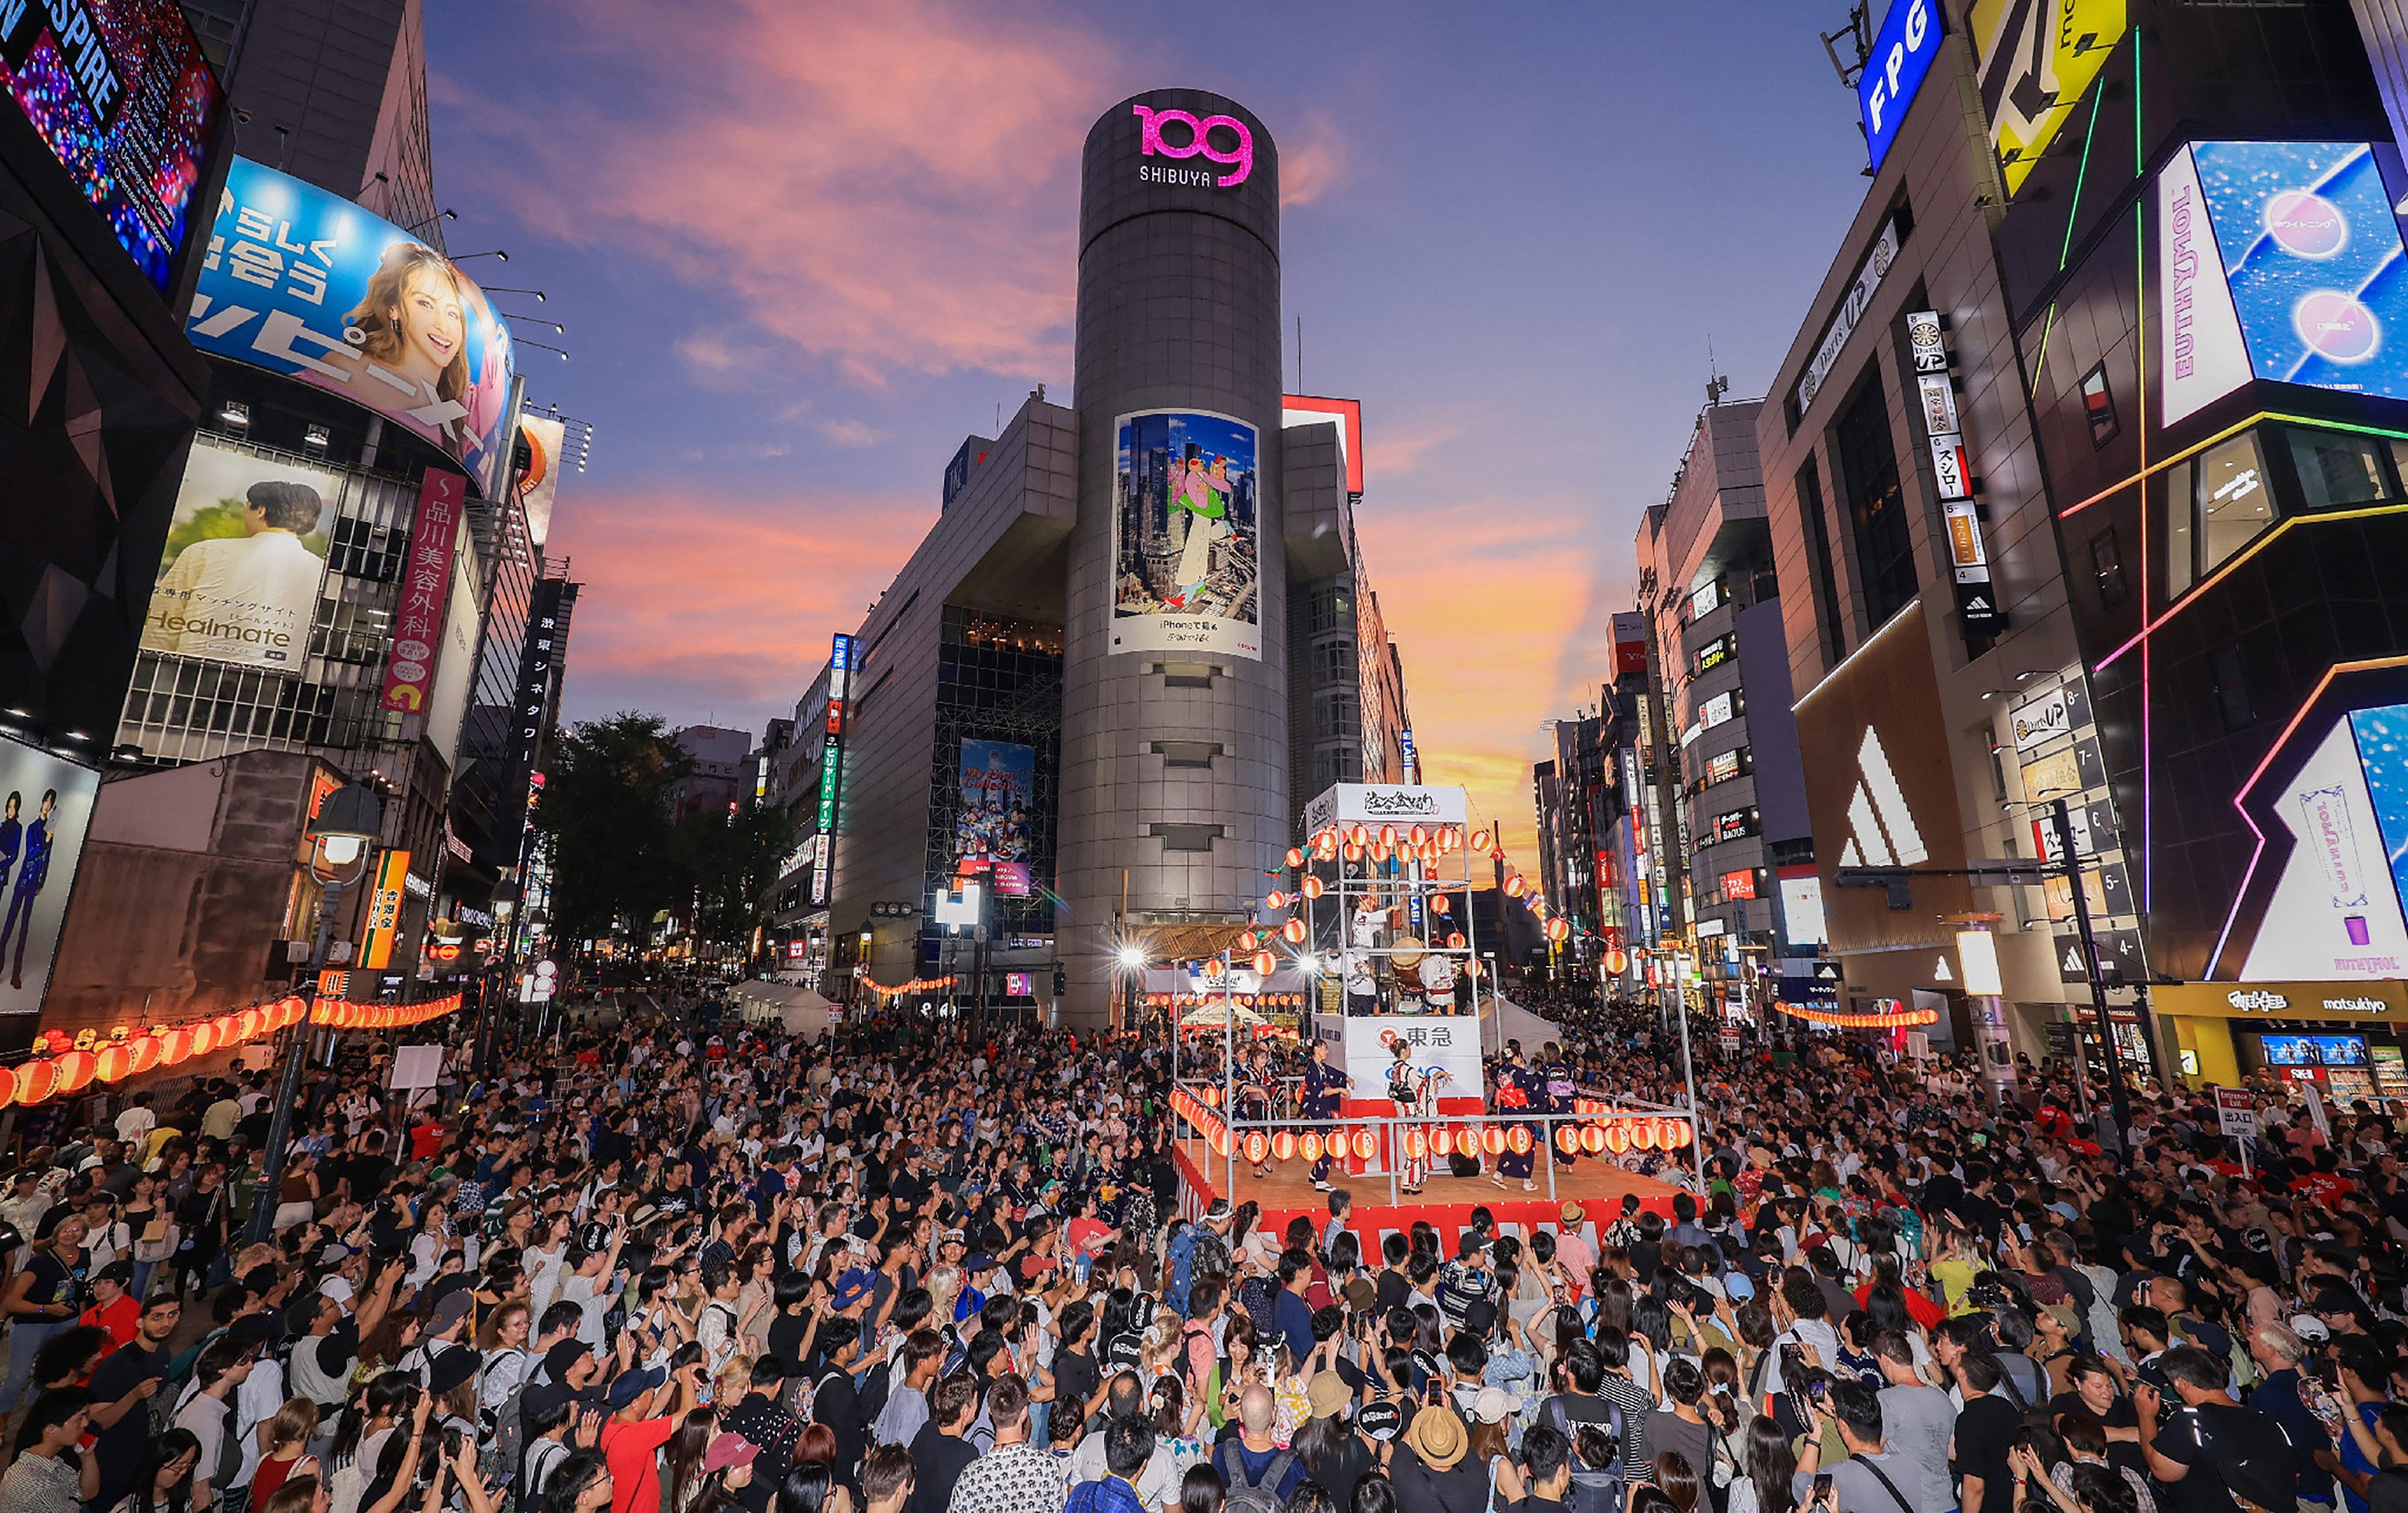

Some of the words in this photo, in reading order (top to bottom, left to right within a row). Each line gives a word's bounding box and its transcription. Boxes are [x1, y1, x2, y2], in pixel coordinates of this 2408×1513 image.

[42, 0, 119, 121] SPIRE
[1869, 0, 1928, 135] FPG
[1133, 105, 1254, 187] 109
[1140, 166, 1210, 187] SHIBUYA
[2172, 185, 2198, 381] EUTHYMOL
[1820, 328, 1844, 370] Darts
[1844, 279, 1867, 330] UP
[1915, 347, 1942, 355] Darts
[1915, 355, 1945, 370] UP
[1938, 449, 1957, 496] スシロー
[402, 500, 452, 640] 品川美容外科
[146, 608, 291, 648] Healmate
[522, 616, 555, 763] 渋東シネタワー
[2045, 703, 2064, 727] UP
[820, 748, 837, 827] ビリヤード・ダーツ
[1411, 896, 1421, 925] LABI
[2322, 997, 2387, 1014] matsukiyo
[1406, 1026, 1454, 1047] 東急
[2290, 1068, 2315, 1080] SK-II
[2220, 1091, 2248, 1100] Entrance
[2229, 1099, 2242, 1108] Exit
[2225, 1111, 2253, 1124] 出入口
